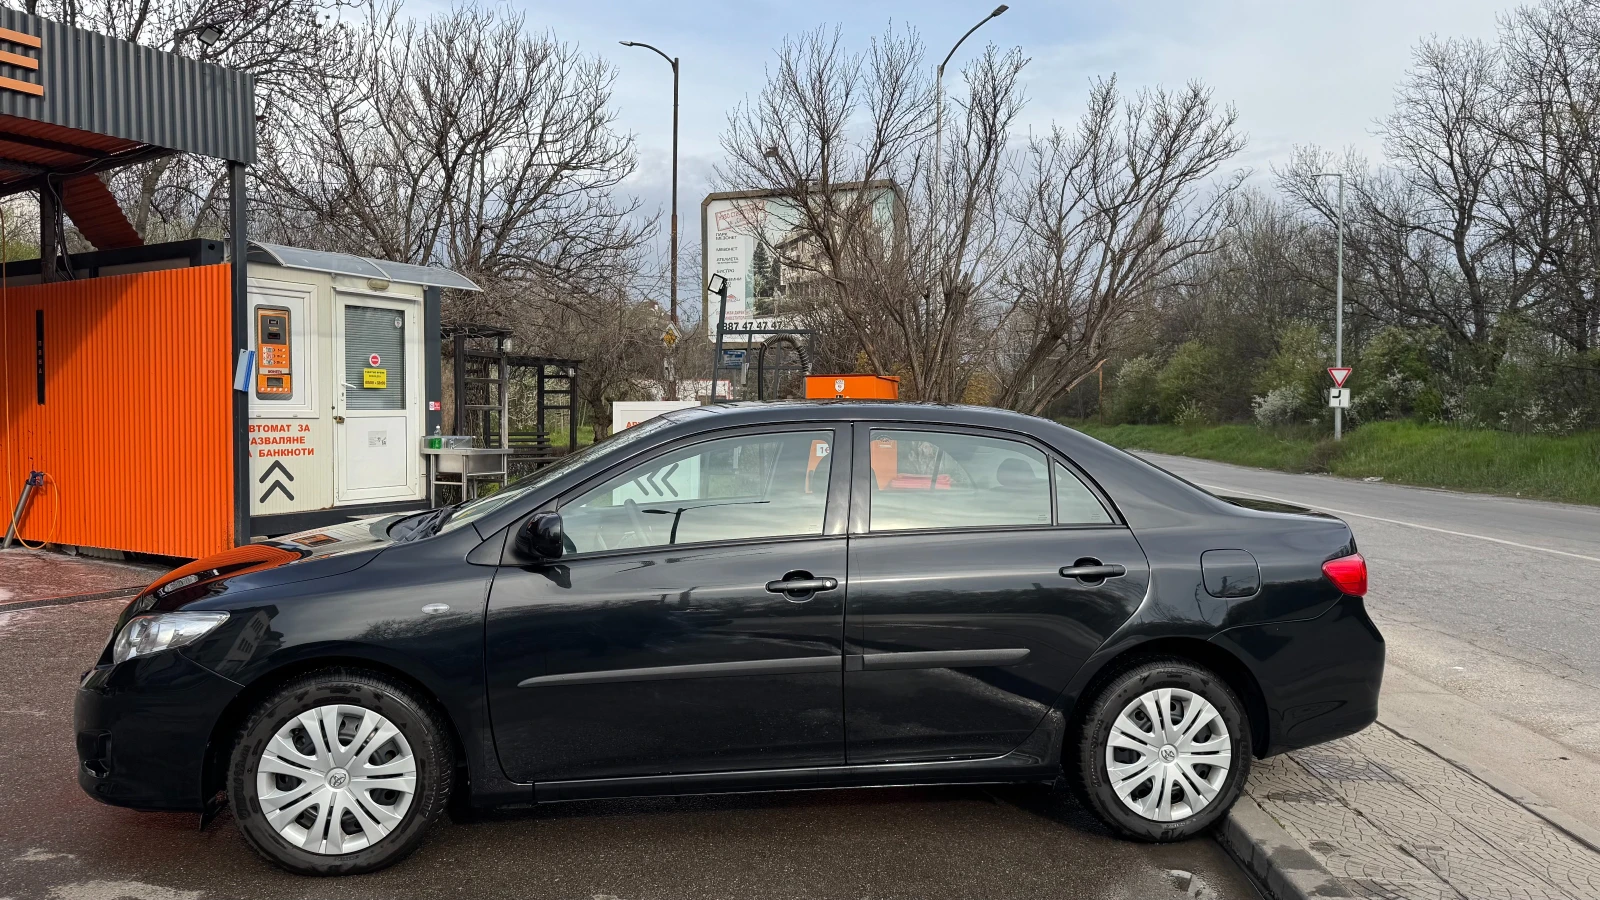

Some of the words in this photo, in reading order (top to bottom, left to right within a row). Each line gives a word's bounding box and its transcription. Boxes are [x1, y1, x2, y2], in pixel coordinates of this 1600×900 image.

[717, 322, 739, 331] 887
[742, 322, 753, 331] 47
[757, 322, 768, 331] 47
[249, 424, 291, 433] ВТОМАТ
[297, 424, 310, 432] ЗА
[249, 436, 306, 445] АЗВАЛЯНЕ
[258, 448, 315, 457] БАНКНОТИ
